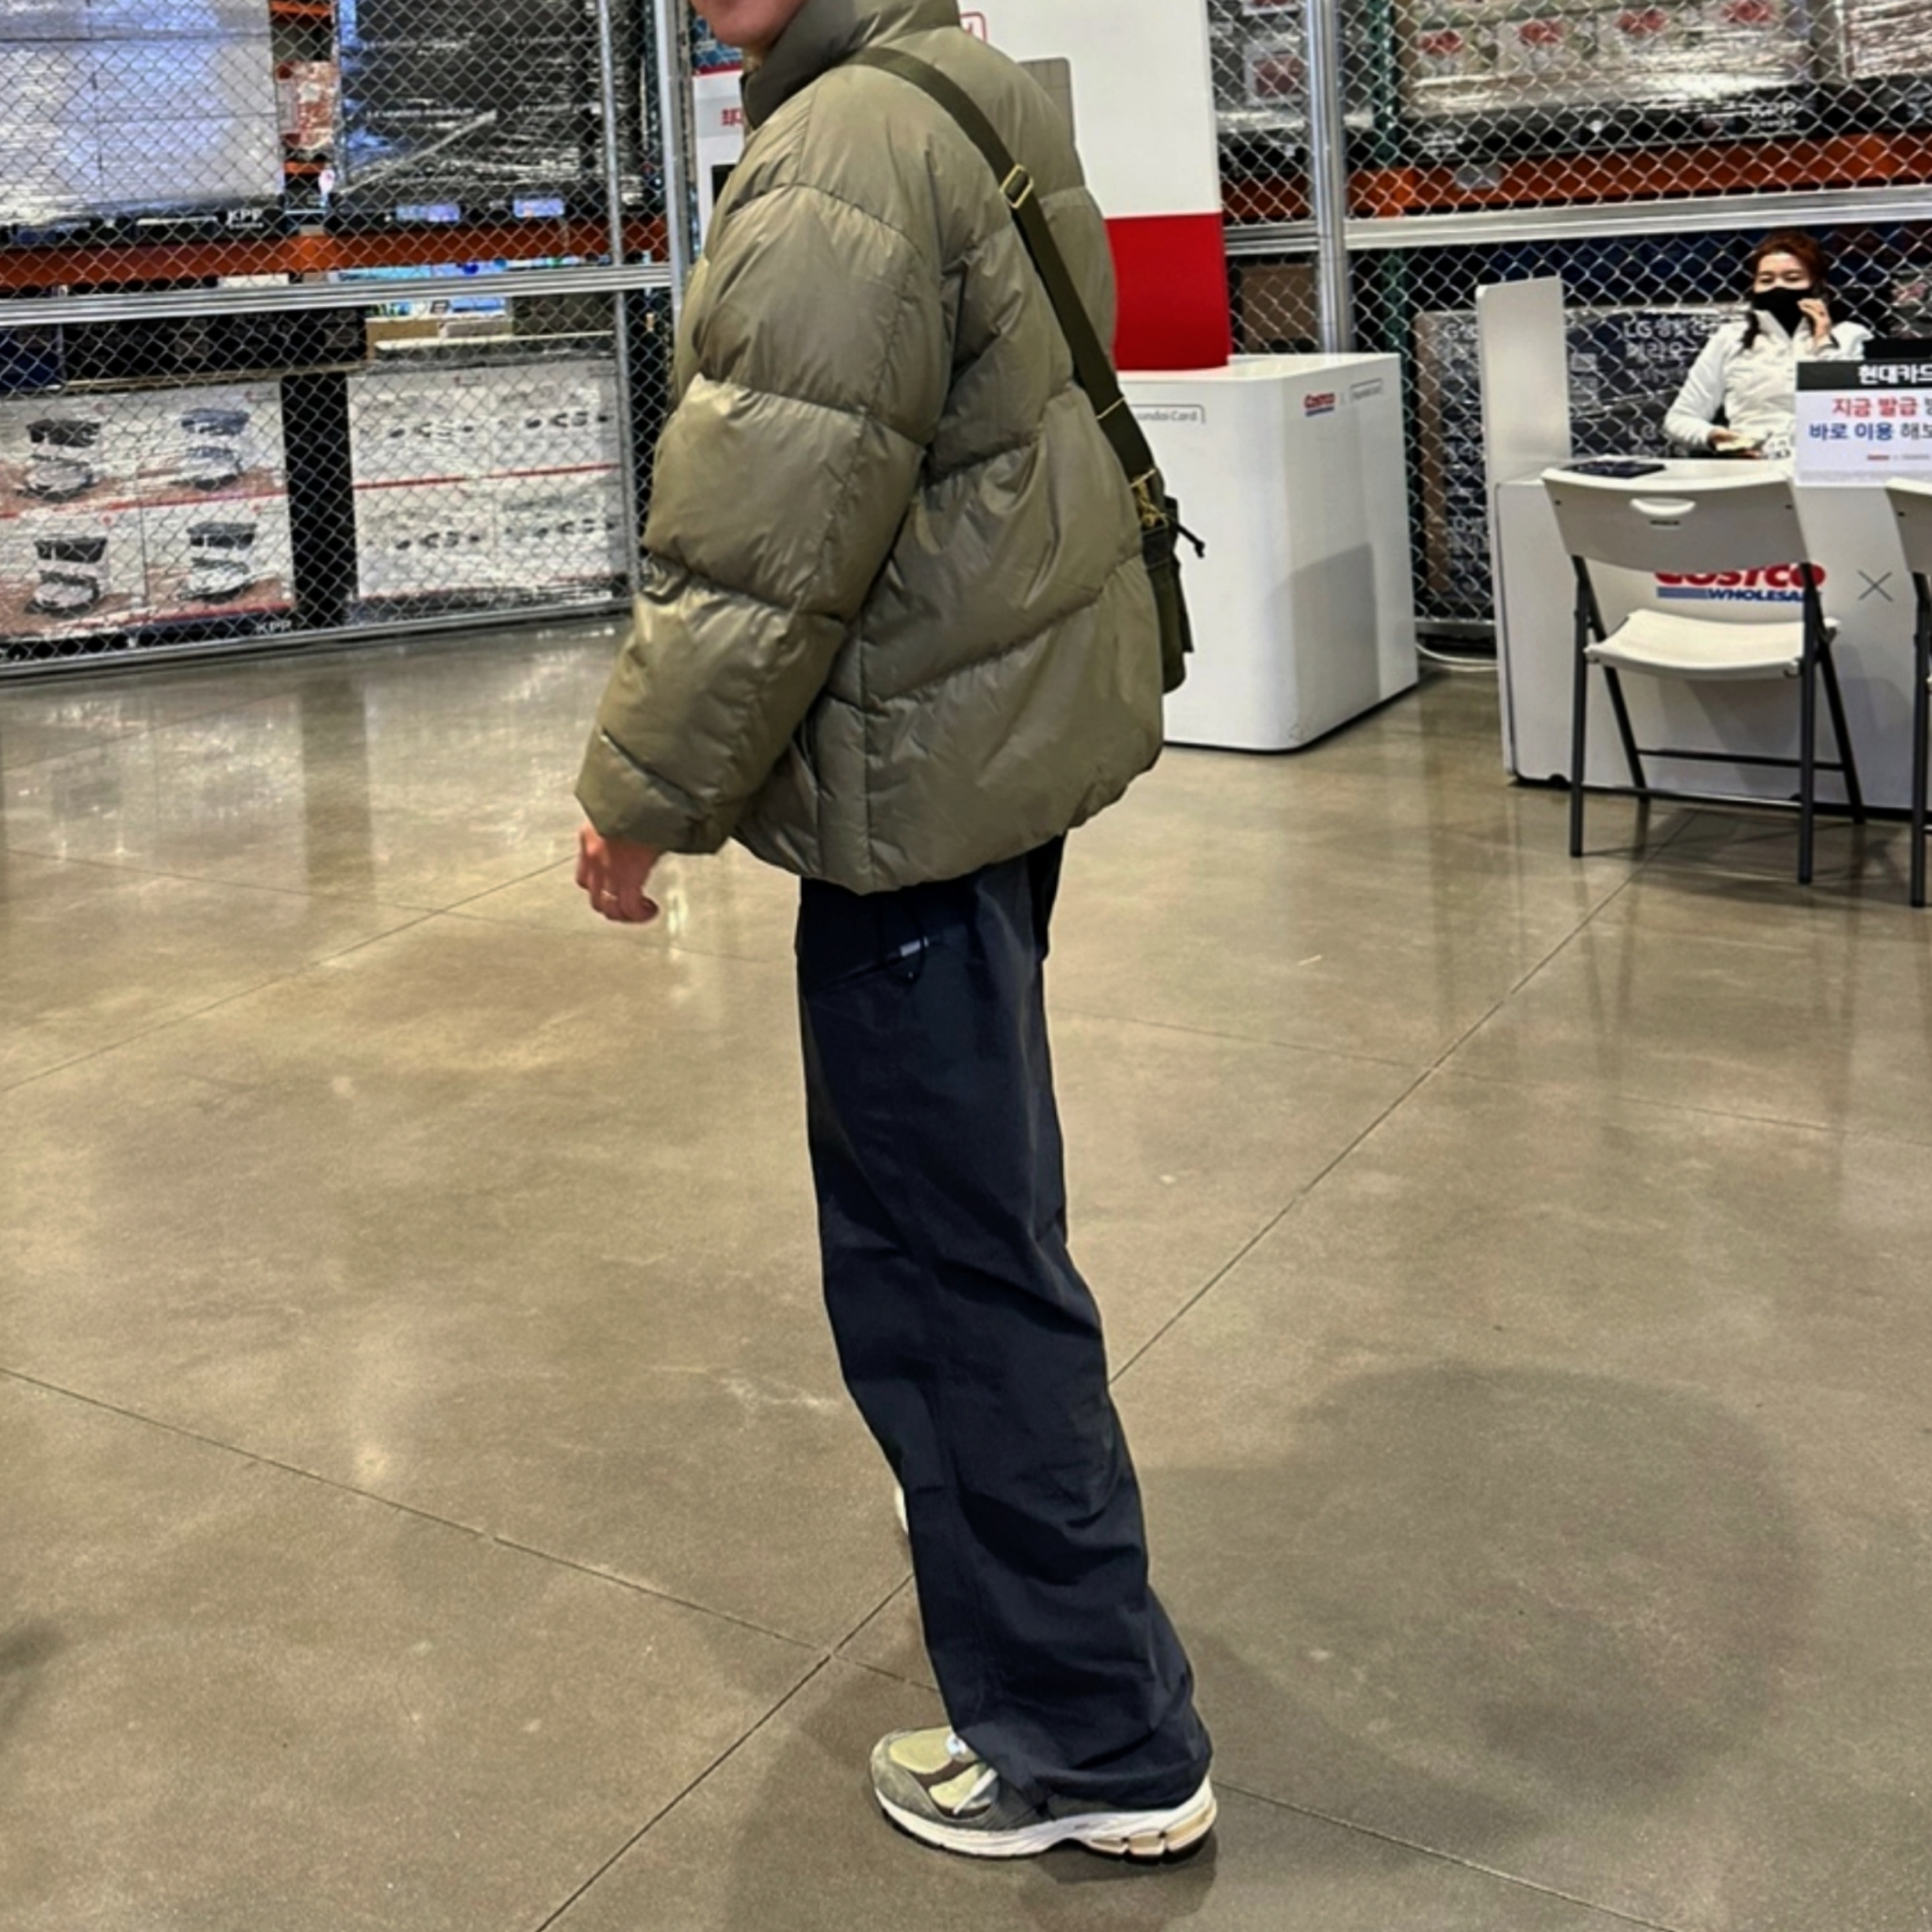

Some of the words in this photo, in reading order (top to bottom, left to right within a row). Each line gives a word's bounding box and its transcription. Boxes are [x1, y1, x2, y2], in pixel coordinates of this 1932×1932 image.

[1859, 364, 1932, 385] 현대카드
[1832, 397, 1871, 417] 지금
[1878, 396, 1917, 417] 발급
[1809, 423, 1848, 441] 바로
[1853, 422, 1893, 440] 이용
[1706, 587, 1804, 602] WHOLESA
